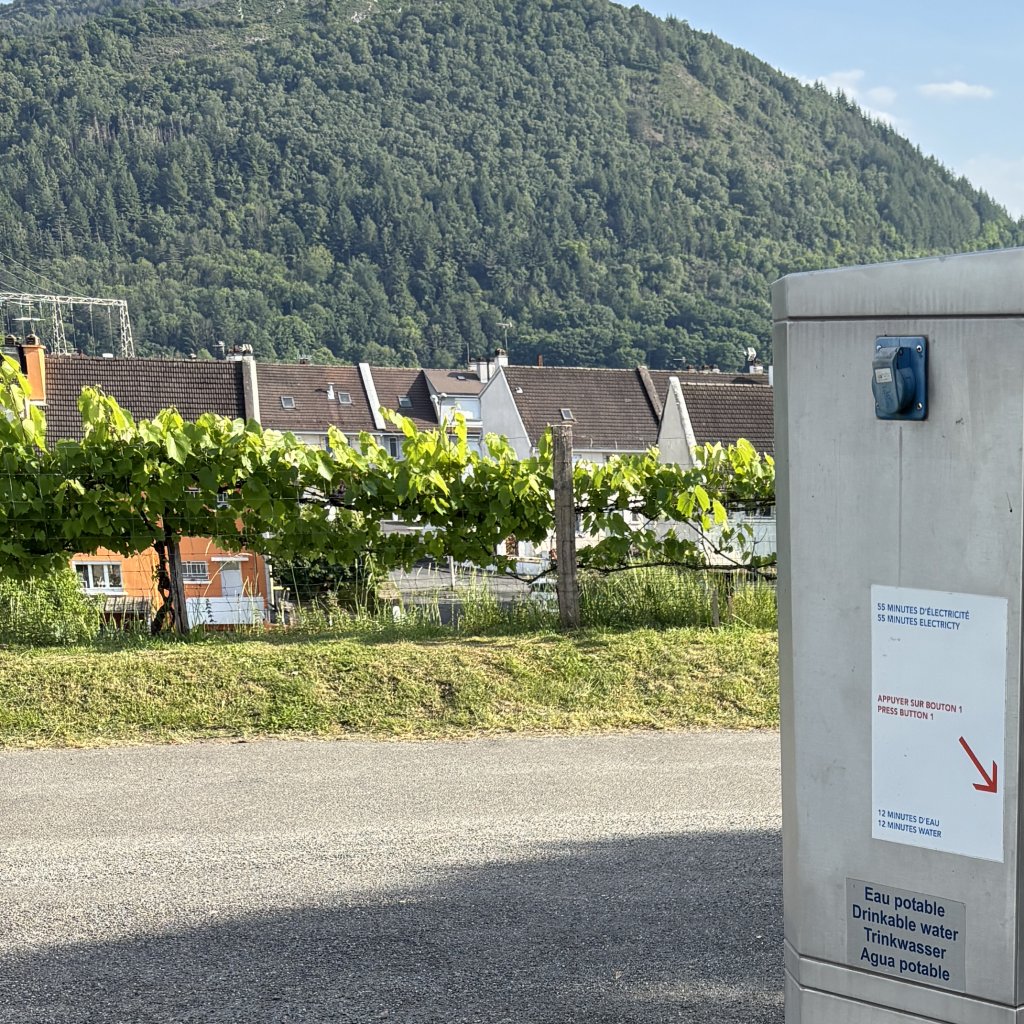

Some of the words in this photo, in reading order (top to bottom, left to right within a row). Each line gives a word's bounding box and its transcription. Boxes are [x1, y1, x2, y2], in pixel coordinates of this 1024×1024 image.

[877, 603, 886, 611] 55
[887, 604, 918, 615] MINUTES
[920, 606, 970, 620] D'ÉLECTRICITÉ
[877, 614, 886, 622] 55
[887, 615, 918, 626] MINUTES
[920, 618, 960, 630] ELECTRICTY
[878, 695, 909, 706] APPUYER
[910, 699, 924, 708] SUR
[926, 701, 957, 713] BOUTON
[878, 705, 898, 715] PRESS
[900, 708, 928, 720] BUTTON
[878, 809, 886, 817] 12
[887, 810, 917, 823] MINUTES
[918, 816, 940, 827] D'EAU
[878, 820, 886, 828] 12
[887, 821, 917, 834] MINUTES
[918, 827, 942, 838] WATER
[864, 886, 890, 905] Eau
[894, 895, 945, 917] potable
[852, 904, 917, 932] Drinkable
[920, 923, 959, 941] water
[864, 927, 947, 959] Trinkwasser
[860, 947, 895, 968] Agua
[900, 959, 951, 981] potable
